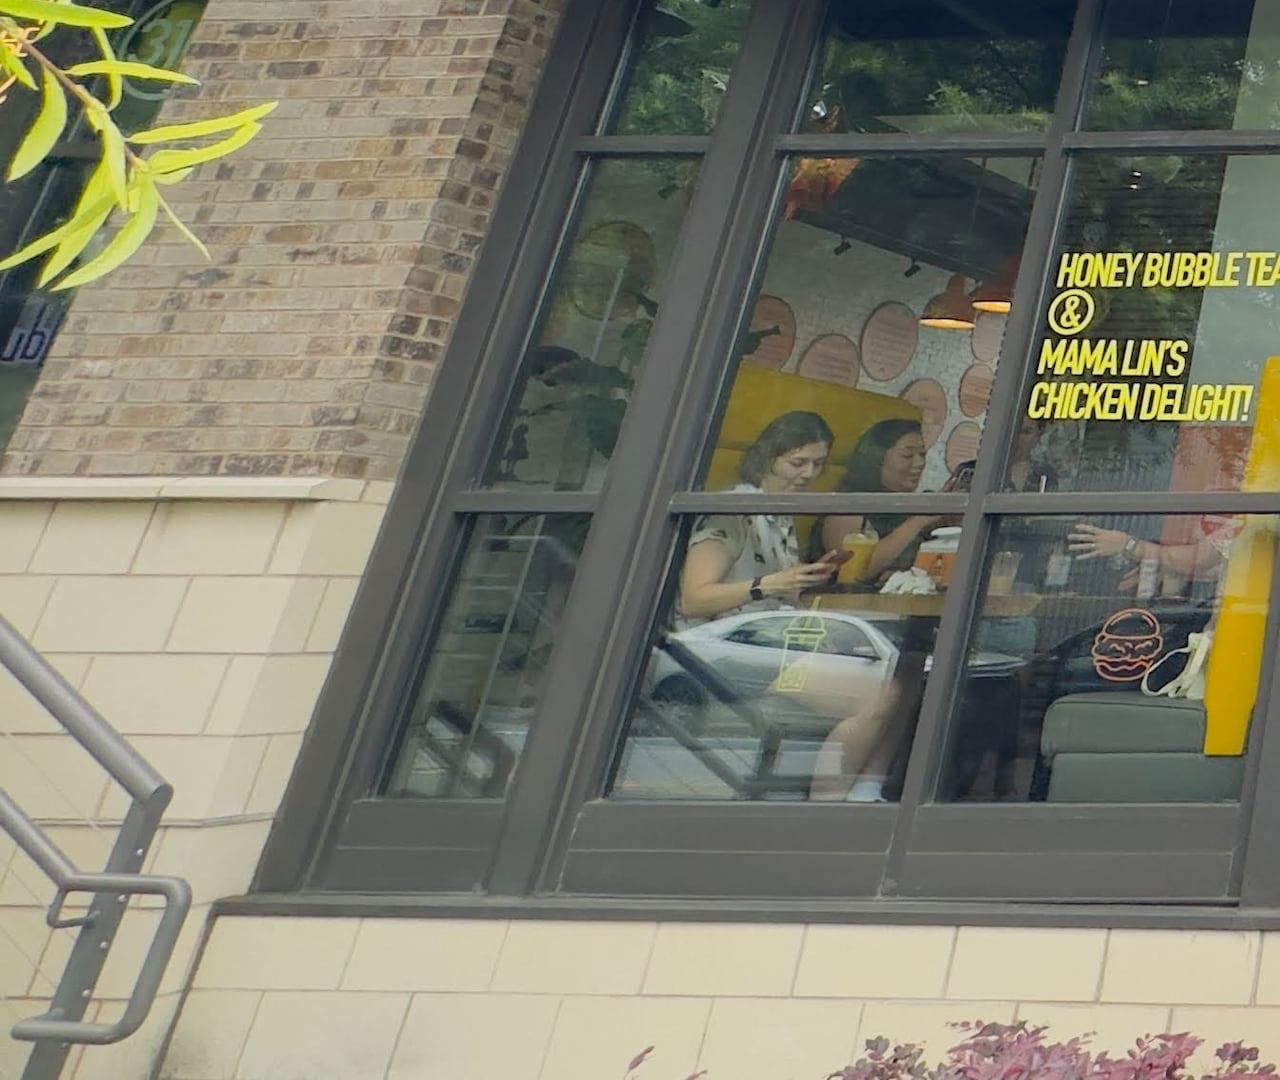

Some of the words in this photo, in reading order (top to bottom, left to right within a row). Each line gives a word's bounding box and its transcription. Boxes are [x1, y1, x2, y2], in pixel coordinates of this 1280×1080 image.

[1056, 252, 1144, 288] HONEY
[1143, 252, 1247, 288] BUBBLE
[1036, 338, 1118, 375] MAMA
[1121, 339, 1189, 376] LIN'S
[1027, 382, 1140, 420] CHICKEN
[1142, 383, 1254, 422] DELIGHT!
